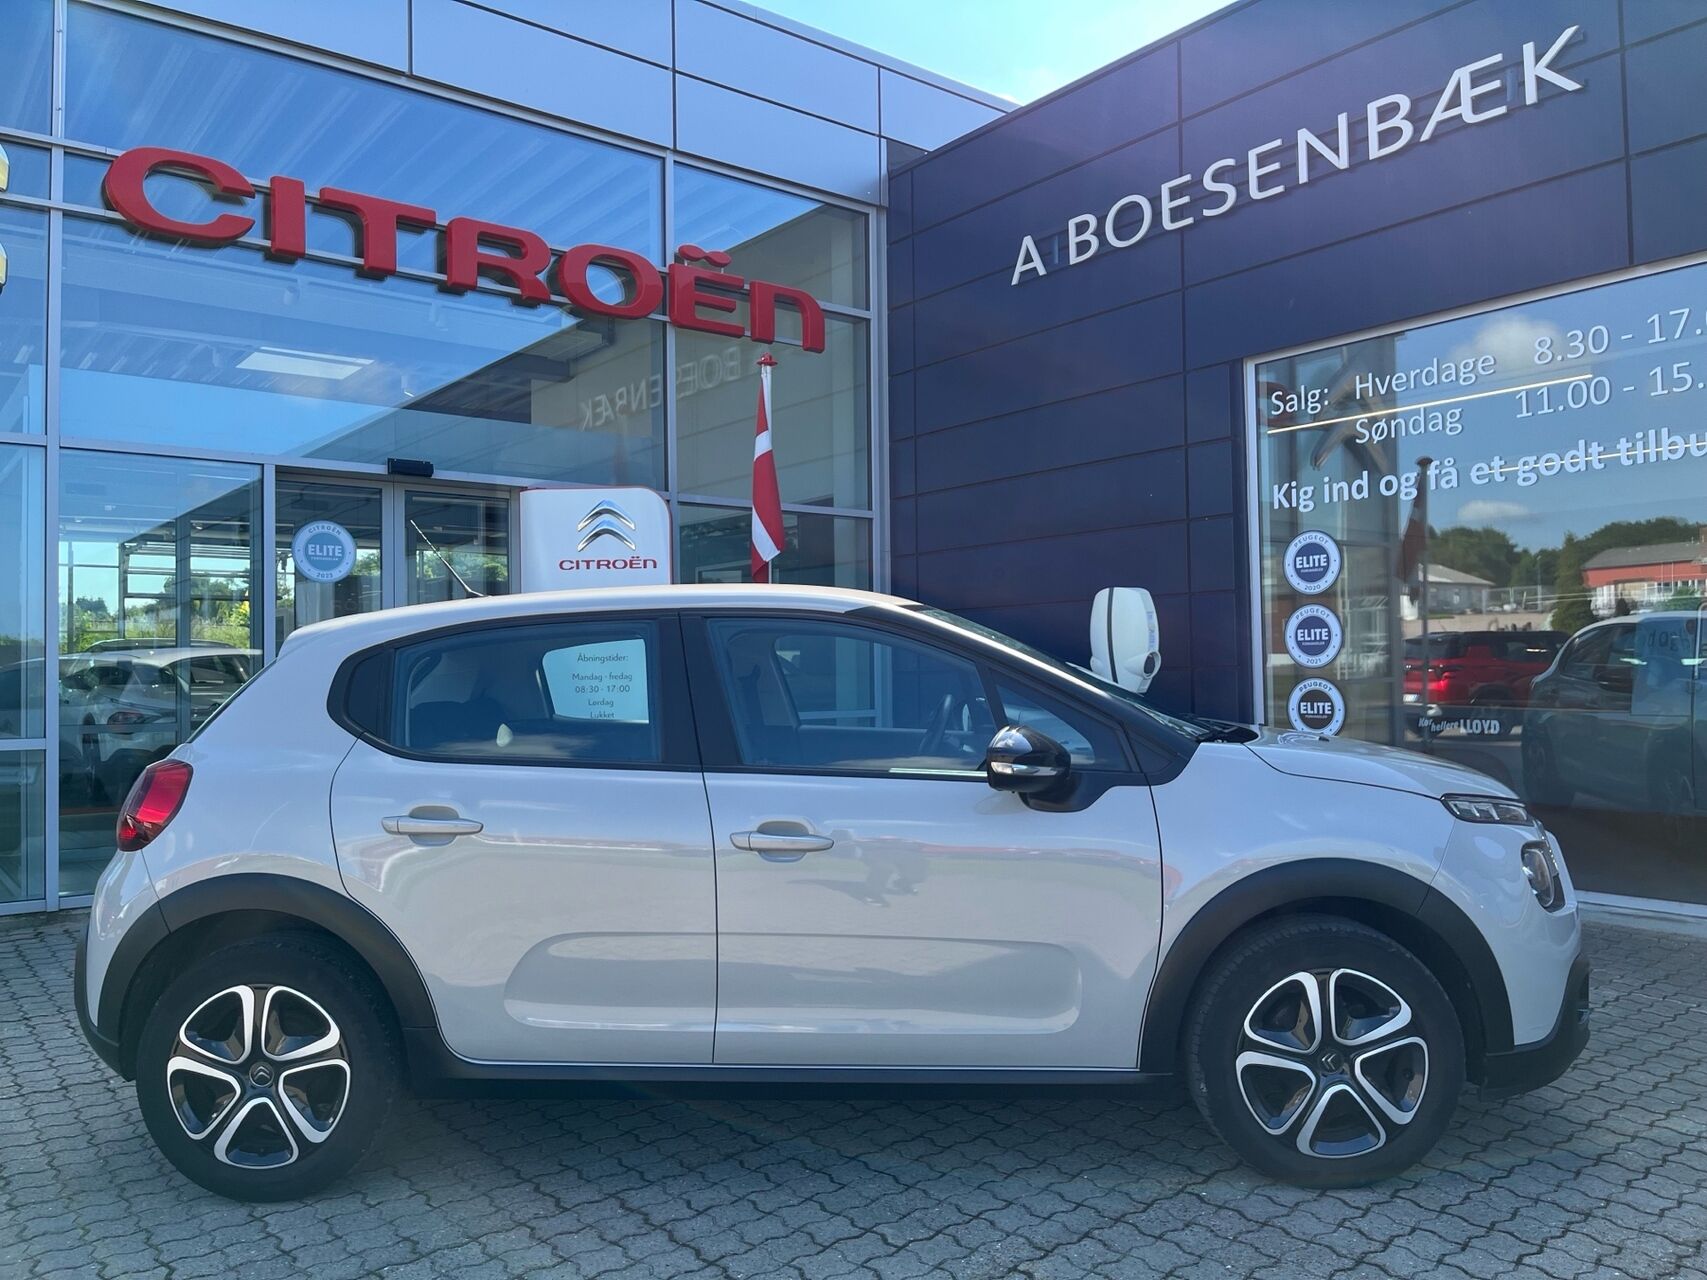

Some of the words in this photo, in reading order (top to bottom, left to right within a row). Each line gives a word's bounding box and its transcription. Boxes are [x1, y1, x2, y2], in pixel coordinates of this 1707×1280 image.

[1010, 235, 1048, 287] A
[1067, 25, 1585, 267] BOESENBÆK
[103, 147, 825, 354] CITROËN
[1271, 385, 1329, 416] Salg:
[1355, 354, 1496, 400] Hverdage
[1533, 325, 1610, 365] 8.30
[1620, 333, 1634, 341] -
[1647, 307, 1707, 344] 17.
[1355, 408, 1463, 444] Søndag
[1515, 376, 1611, 418] 11.00
[1273, 481, 1315, 513] Kig
[1323, 470, 1369, 503] ind
[1379, 473, 1418, 500] og
[1427, 457, 1458, 491] få
[1470, 455, 1506, 485] et
[1517, 439, 1606, 487] godt
[1616, 427, 1707, 466] tilbu
[1294, 534, 1329, 548] PEUGEOT
[308, 544, 343, 557] ELITE
[559, 556, 657, 571] CITROËN
[1296, 554, 1327, 569] ELITE
[1295, 608, 1330, 620] PEUGEOT
[1297, 628, 1329, 641] ELITE
[577, 653, 629, 664] Åbningstider:
[572, 673, 603, 682] Mandag
[609, 672, 632, 682] fredag
[607, 685, 631, 693] 17:00
[1299, 681, 1333, 692] PEUGEOT
[1300, 702, 1332, 714] ELITE
[1460, 719, 1500, 735] LLOYD
